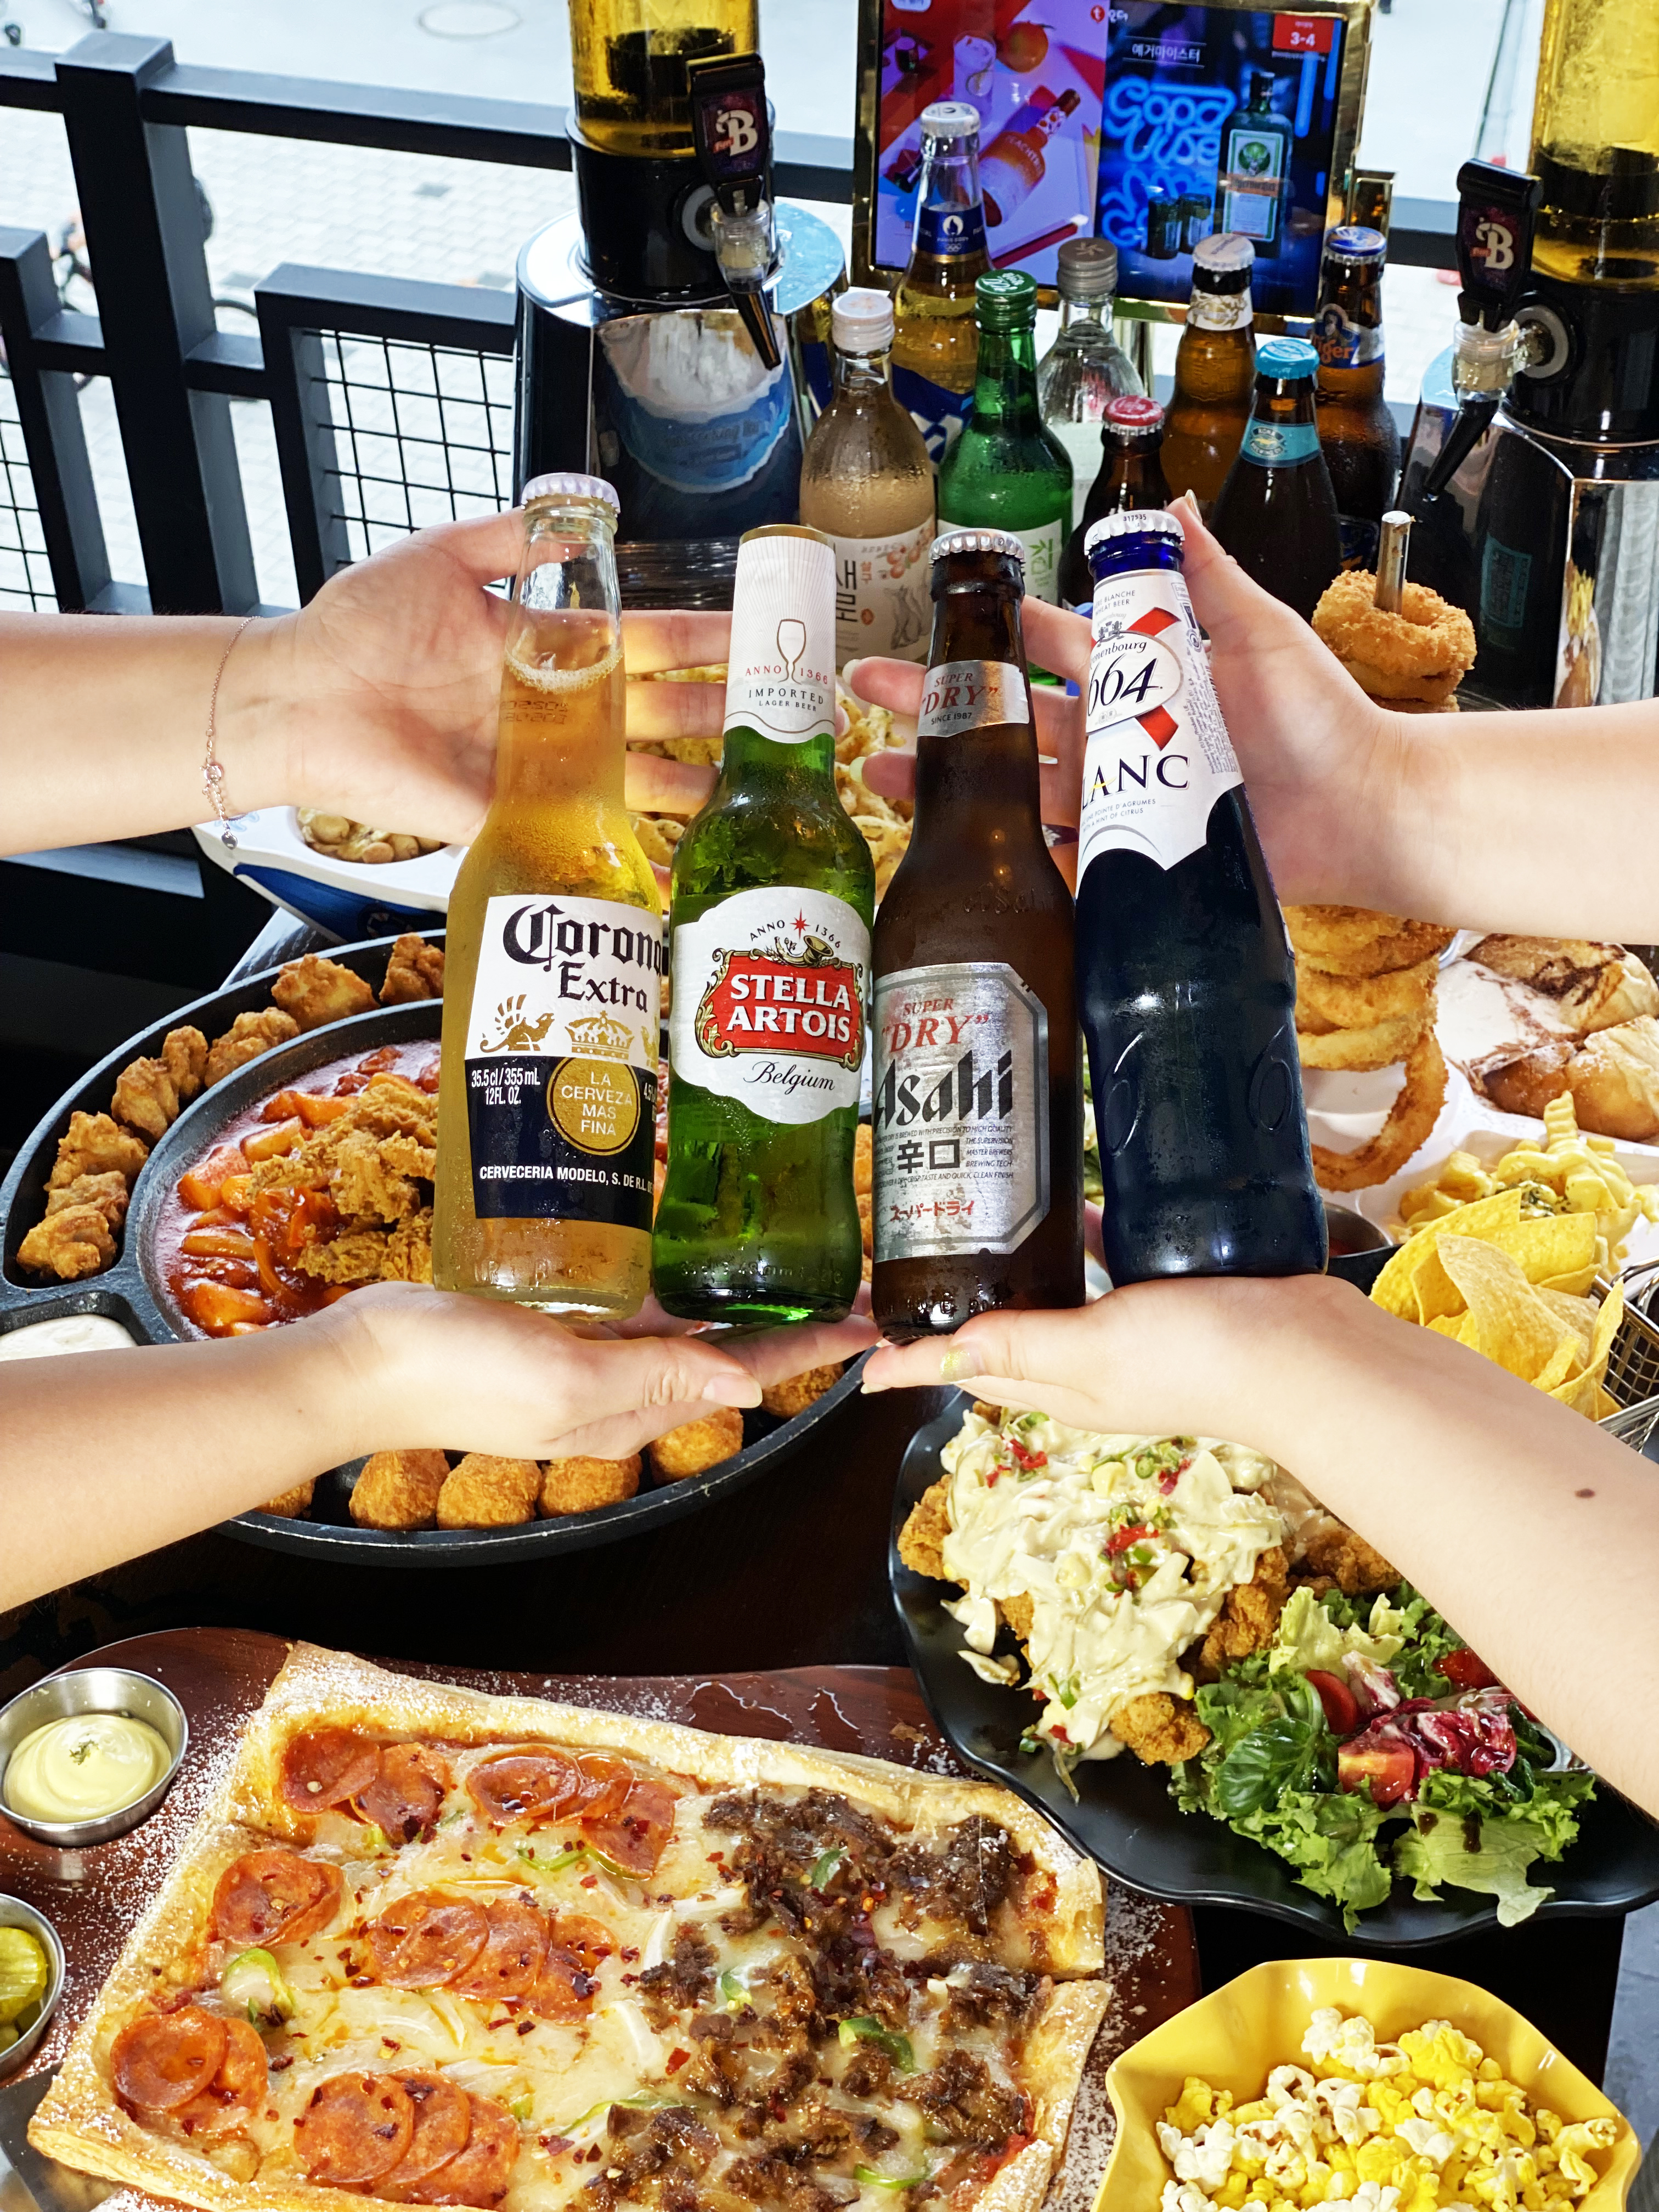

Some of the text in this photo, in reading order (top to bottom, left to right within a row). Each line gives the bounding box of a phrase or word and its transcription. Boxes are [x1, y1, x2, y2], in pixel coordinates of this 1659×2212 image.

[1290, 32, 1315, 46] 3-4
[1132, 43, 1200, 63] 예거마이스터
[1104, 590, 1136, 602] BLANCHE
[1113, 599, 1130, 607] BEER
[745, 665, 828, 685] ANNO 1366
[935, 673, 973, 687] SUPER
[1088, 653, 1159, 716] 664
[749, 688, 823, 705] IMPORTED
[795, 702, 817, 712] BEER
[931, 712, 972, 725] SINCE 1987
[1082, 755, 1189, 810] LANC
[1095, 805, 1113, 816] POINTE
[1096, 815, 1108, 824] HINT
[1121, 808, 1144, 816] CITRUS
[503, 904, 662, 977] Corona
[750, 919, 841, 949] ANNO 1366
[557, 961, 648, 1013] Extra
[730, 974, 851, 1012] STELLA
[904, 998, 954, 1015] SUPER
[726, 1006, 850, 1042] ARTOIS
[591, 1071, 611, 1086] LA
[743, 1060, 835, 1095] Belgium
[508, 1086, 521, 1105] OZ.
[561, 1085, 633, 1106] CERVEZA
[873, 1049, 1013, 1133] Asahi
[582, 1104, 616, 1120] MAS
[581, 1120, 616, 1136] FINA
[900, 1130, 918, 1138] BREWED
[932, 1126, 961, 1134] PRECISION
[898, 1139, 960, 1173] 辛口
[480, 1165, 554, 1180] CERVECERIA
[557, 1167, 609, 1186] MODELO,
[612, 1172, 620, 1185] S.
[623, 1174, 634, 1188] DE
[890, 1200, 974, 1222] スーパードライ
